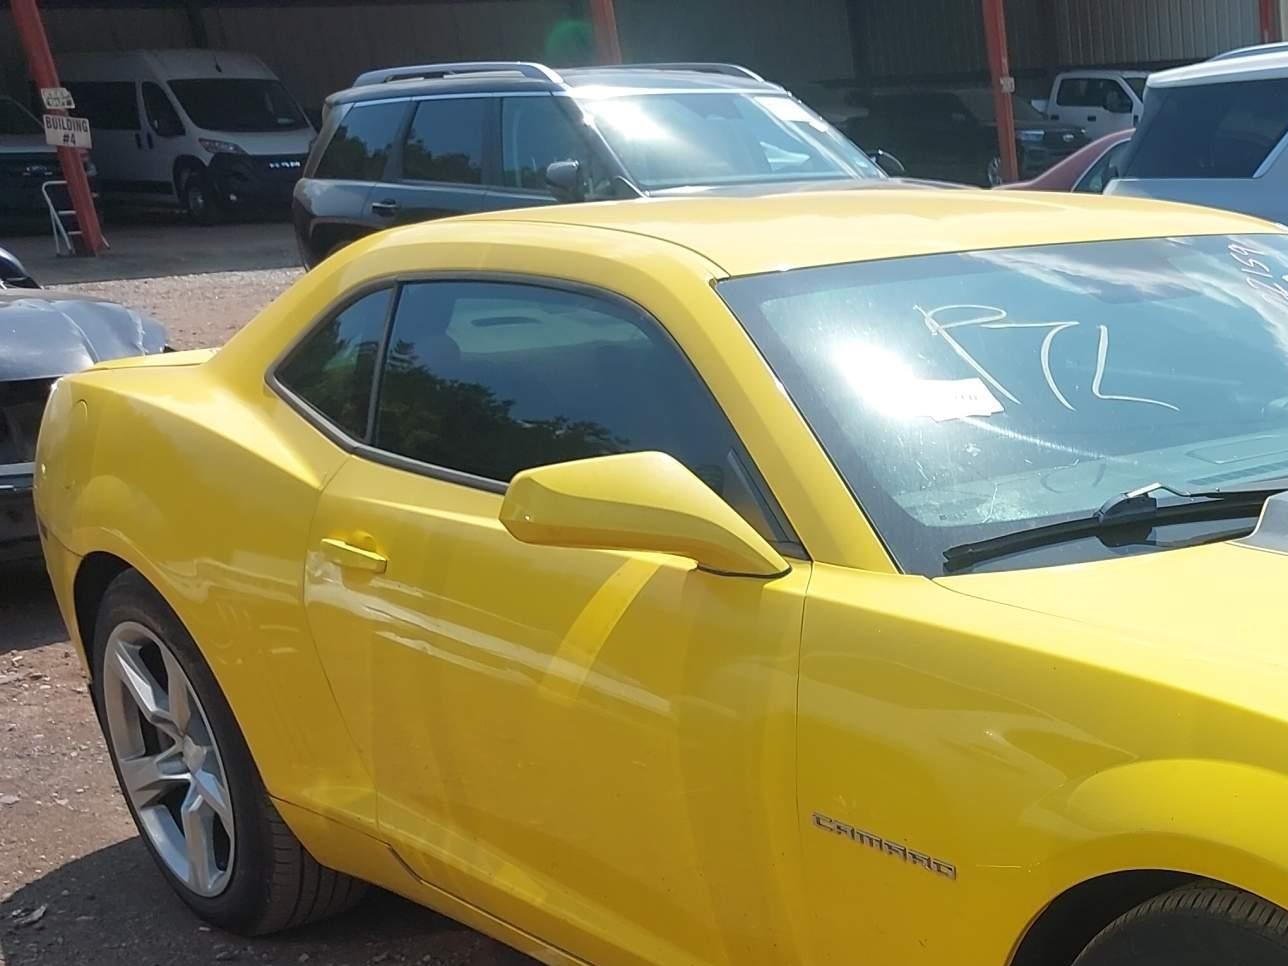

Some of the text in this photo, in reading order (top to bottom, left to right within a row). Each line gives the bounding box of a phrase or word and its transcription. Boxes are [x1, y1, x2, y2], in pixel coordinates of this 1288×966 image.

[45, 116, 89, 133] BUILDING
[62, 134, 76, 145] #4
[812, 812, 957, 880] CAMARO
